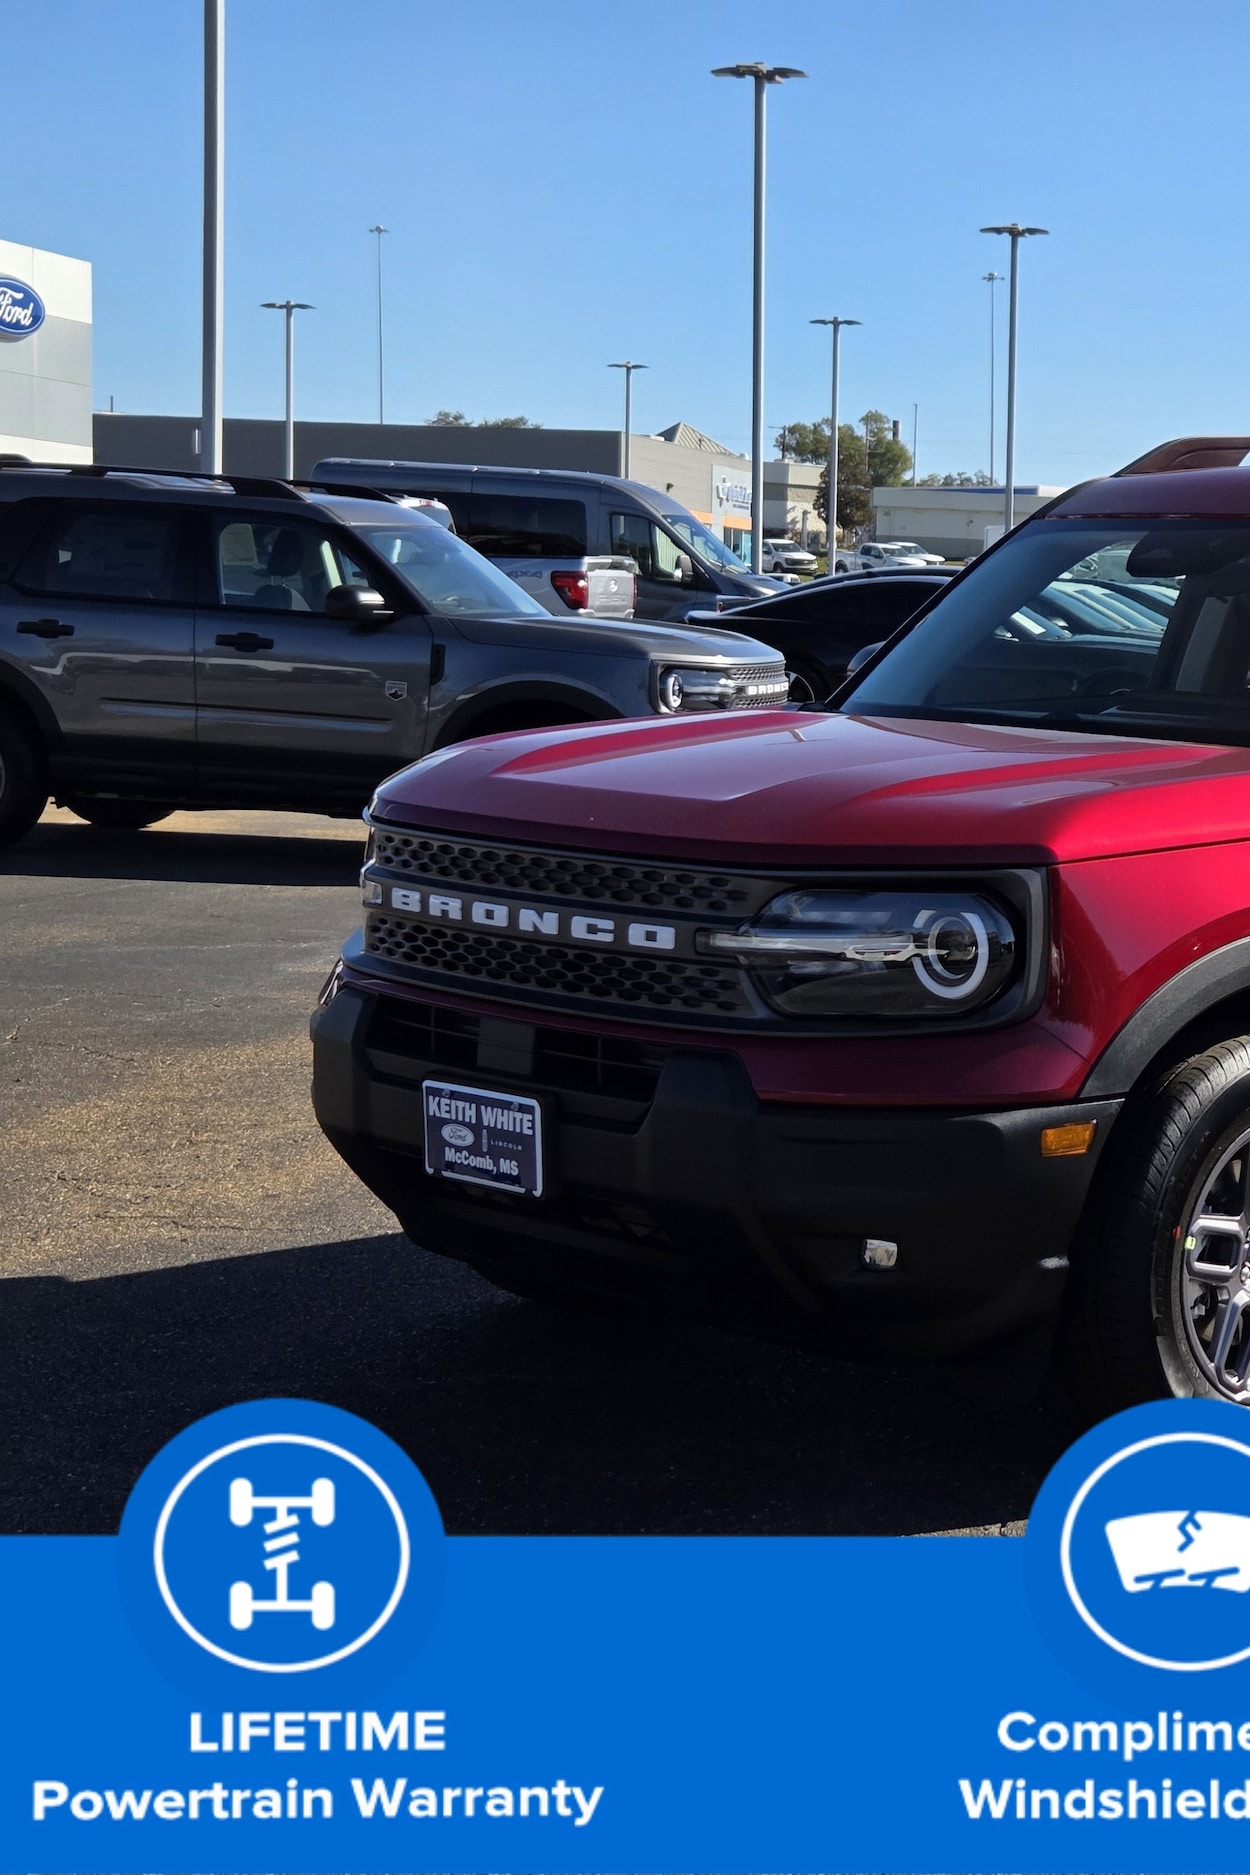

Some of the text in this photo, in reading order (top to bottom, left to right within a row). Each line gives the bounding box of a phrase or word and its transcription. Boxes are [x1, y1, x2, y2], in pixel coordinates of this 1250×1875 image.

[0, 287, 34, 327] Ford
[748, 681, 789, 695] BRONC
[391, 886, 676, 950] BRONCO
[428, 1095, 534, 1136] KEITH WHITE
[448, 1127, 469, 1142] Ford
[444, 1146, 519, 1176] McComb, MS
